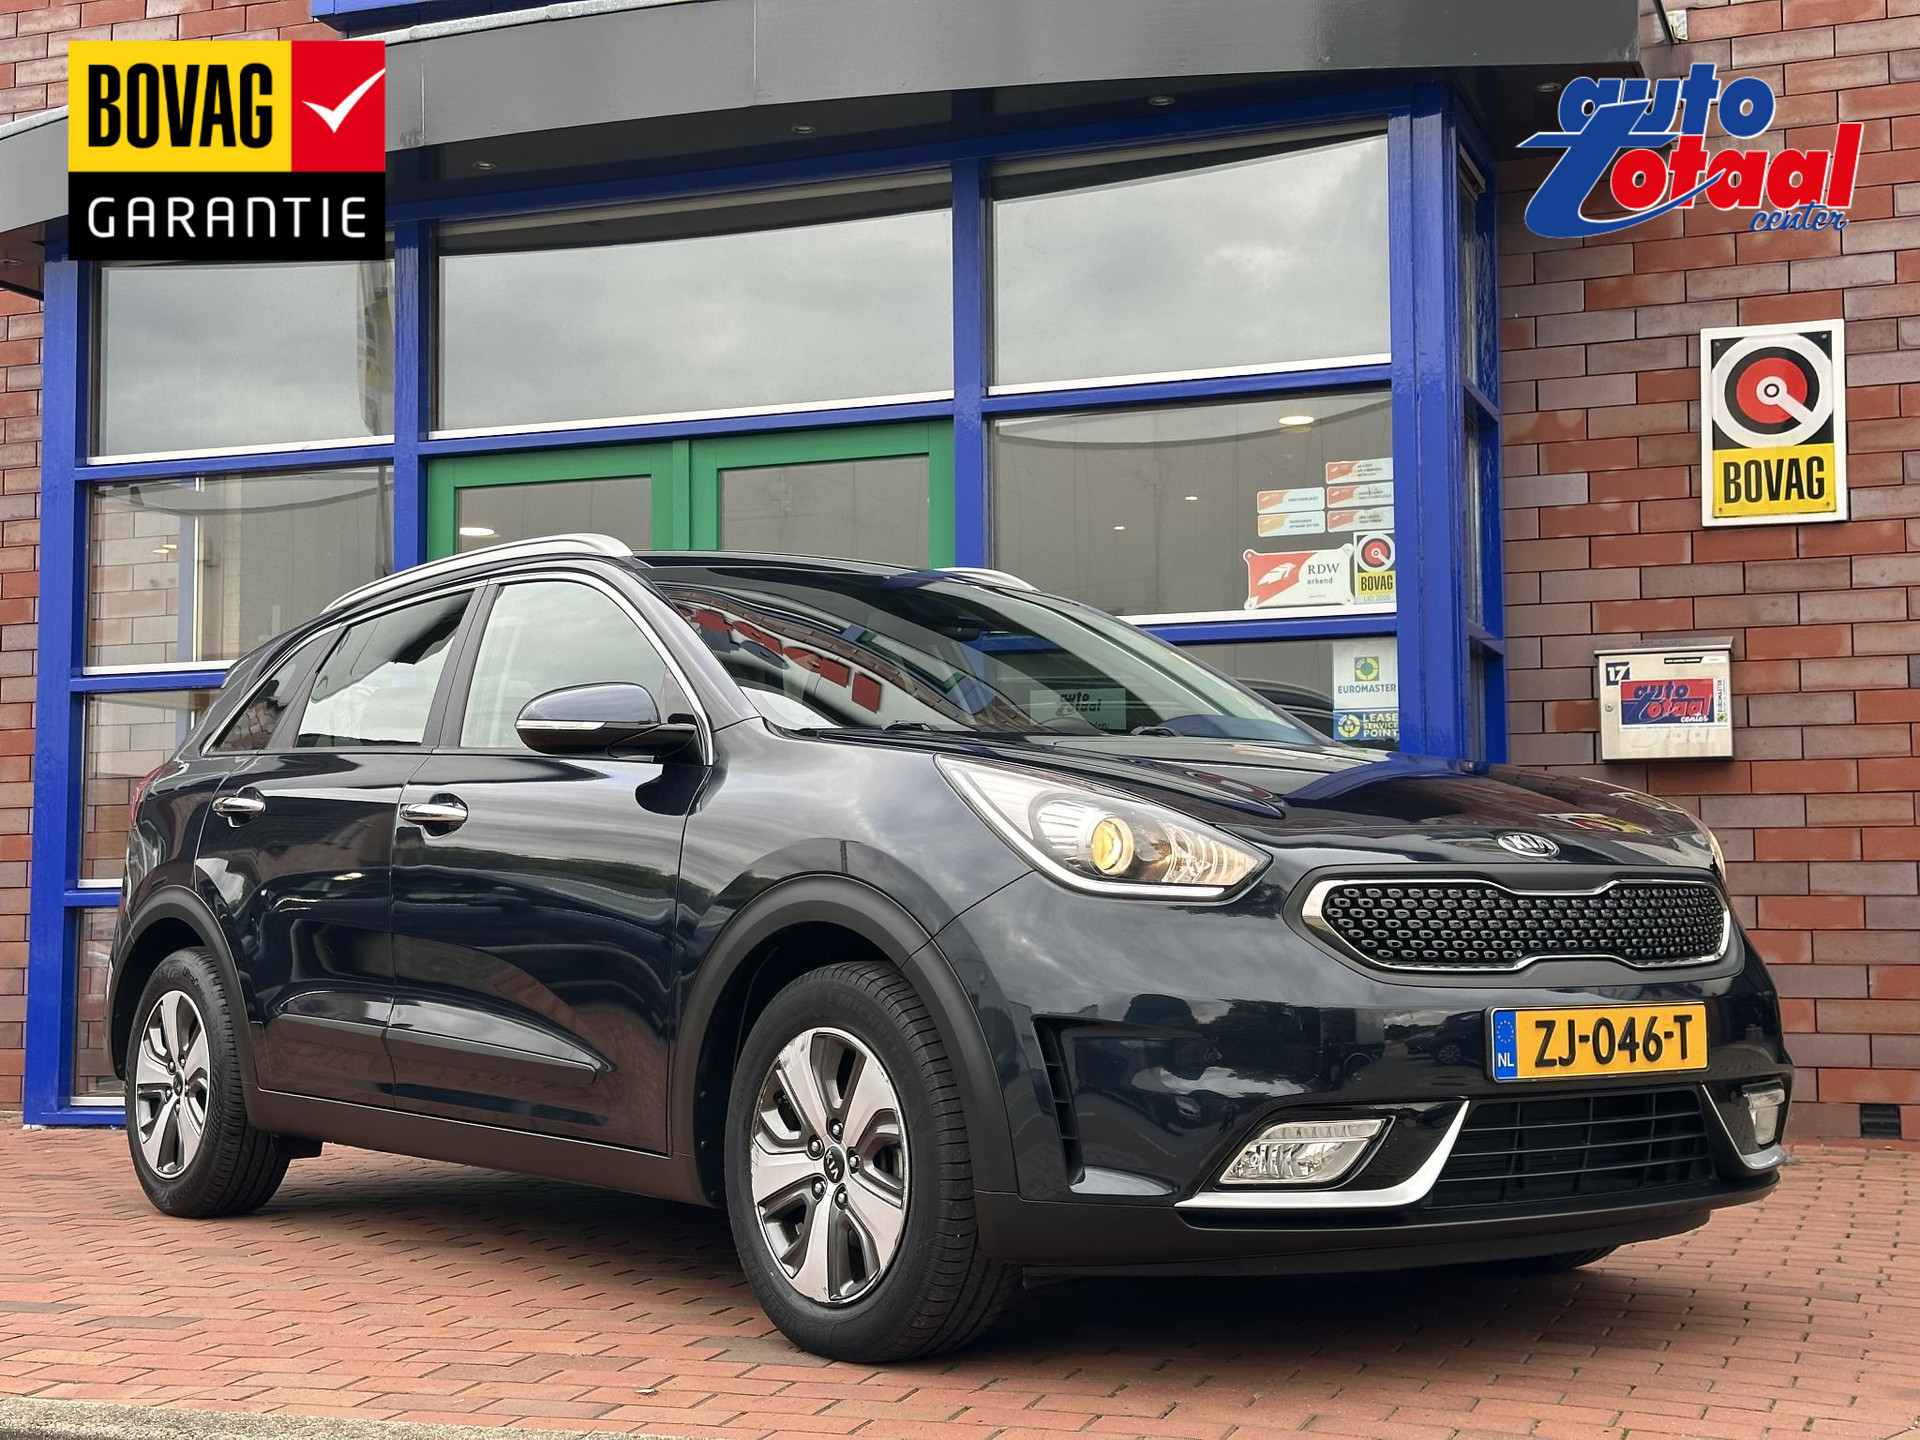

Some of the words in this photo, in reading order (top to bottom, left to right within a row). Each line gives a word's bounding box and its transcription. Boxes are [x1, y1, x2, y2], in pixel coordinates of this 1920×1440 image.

[1723, 456, 1825, 504] BOVAG
[1307, 563, 1340, 575] RDW
[1307, 577, 1333, 586] erkend
[1360, 574, 1394, 592] BOVAG
[1607, 665, 1629, 682] 17
[1338, 684, 1397, 694] EUROMASTER
[1634, 681, 1690, 700] auto
[1363, 713, 1398, 722] LEASE
[1680, 713, 1709, 723] center
[1363, 722, 1398, 730] SERVICE
[1363, 729, 1399, 737] POINT
[1534, 1014, 1694, 1068] ZJ-046-T
[1497, 1052, 1515, 1068] NL
[825, 1149, 839, 1181] KIA
